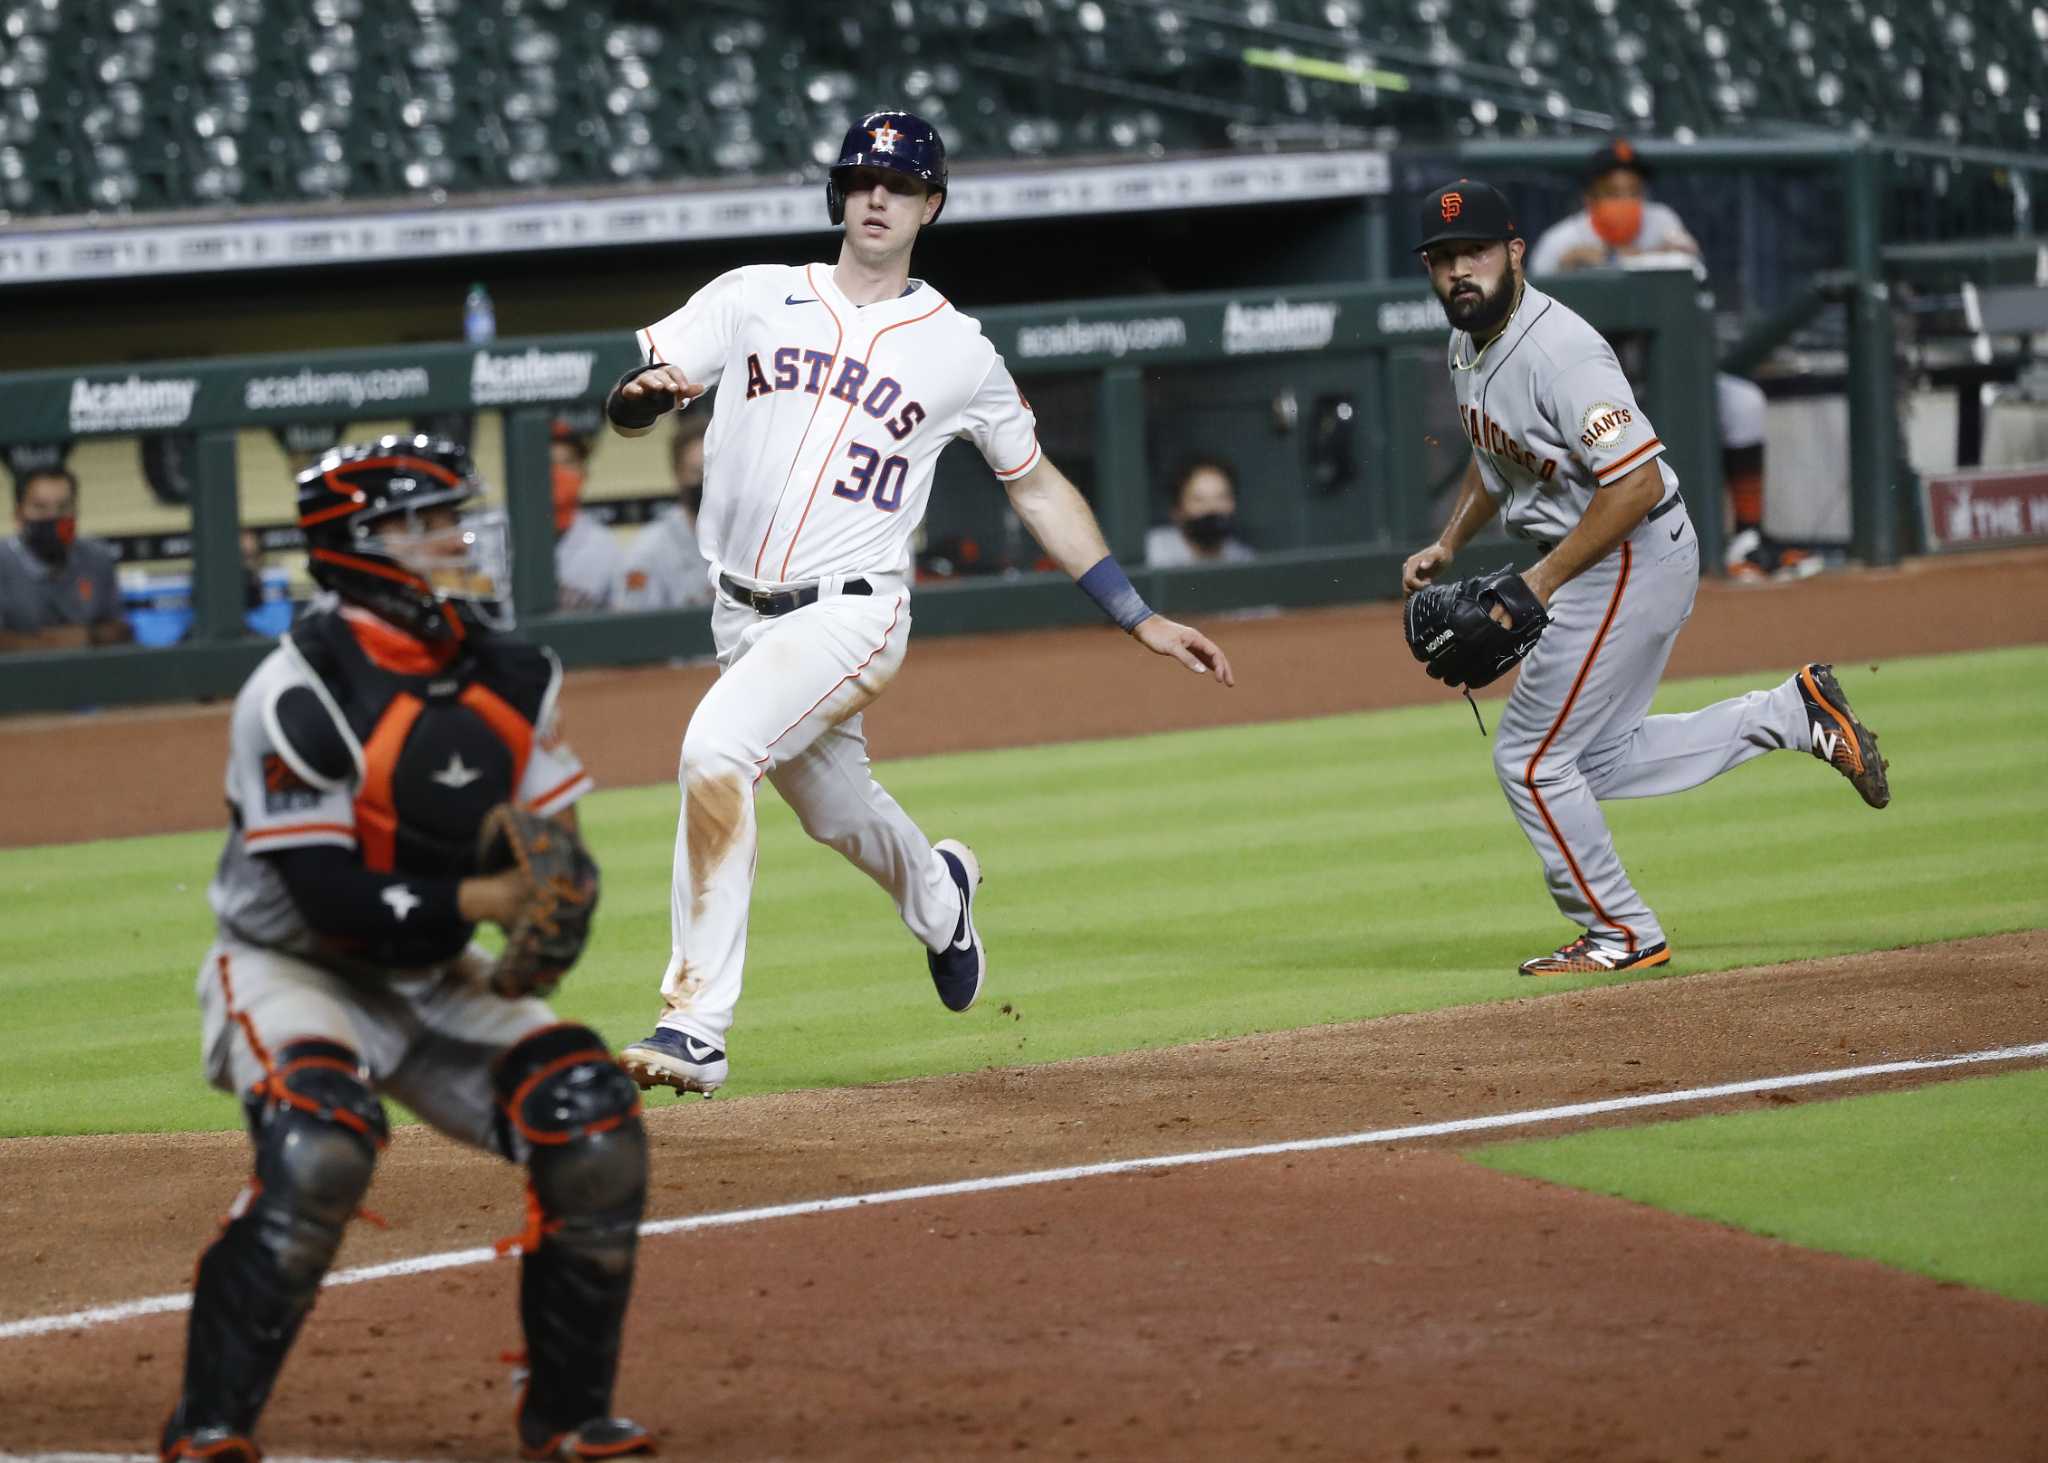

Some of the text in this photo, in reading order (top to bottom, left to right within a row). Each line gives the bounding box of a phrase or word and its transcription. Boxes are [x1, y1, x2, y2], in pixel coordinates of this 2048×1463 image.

[1017, 316, 1186, 357] academy.com
[1224, 298, 1337, 342] Academy
[246, 368, 429, 409] academy.com
[471, 348, 596, 393] Academy
[71, 377, 197, 418] Academy
[746, 347, 926, 441] ASTROS
[1580, 408, 1632, 448] GIANTS
[832, 441, 909, 513] 30
